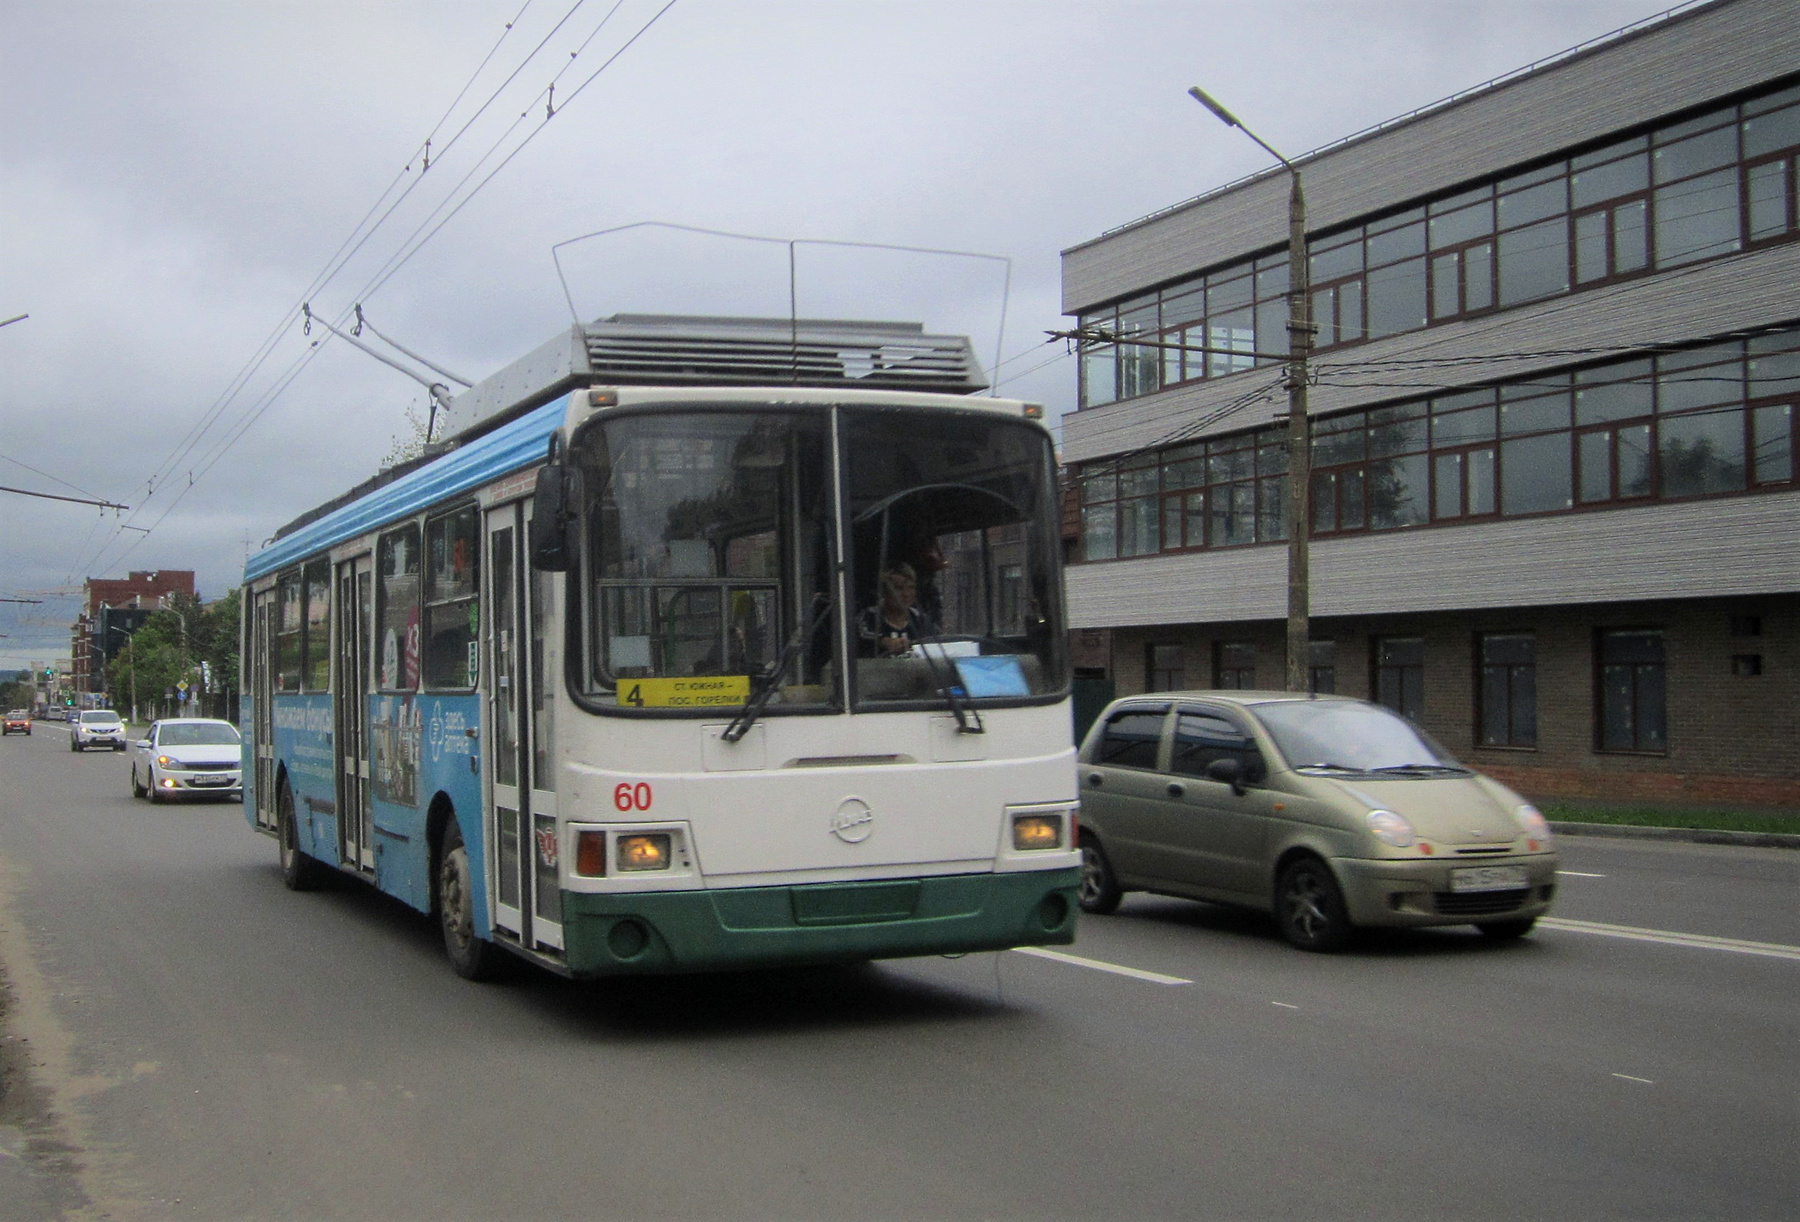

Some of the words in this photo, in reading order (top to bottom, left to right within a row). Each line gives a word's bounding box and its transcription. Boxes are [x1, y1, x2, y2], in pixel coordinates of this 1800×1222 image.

[626, 684, 643, 706] 4
[695, 695, 741, 704] ГОРЕЛКИ
[614, 781, 653, 812] 60
